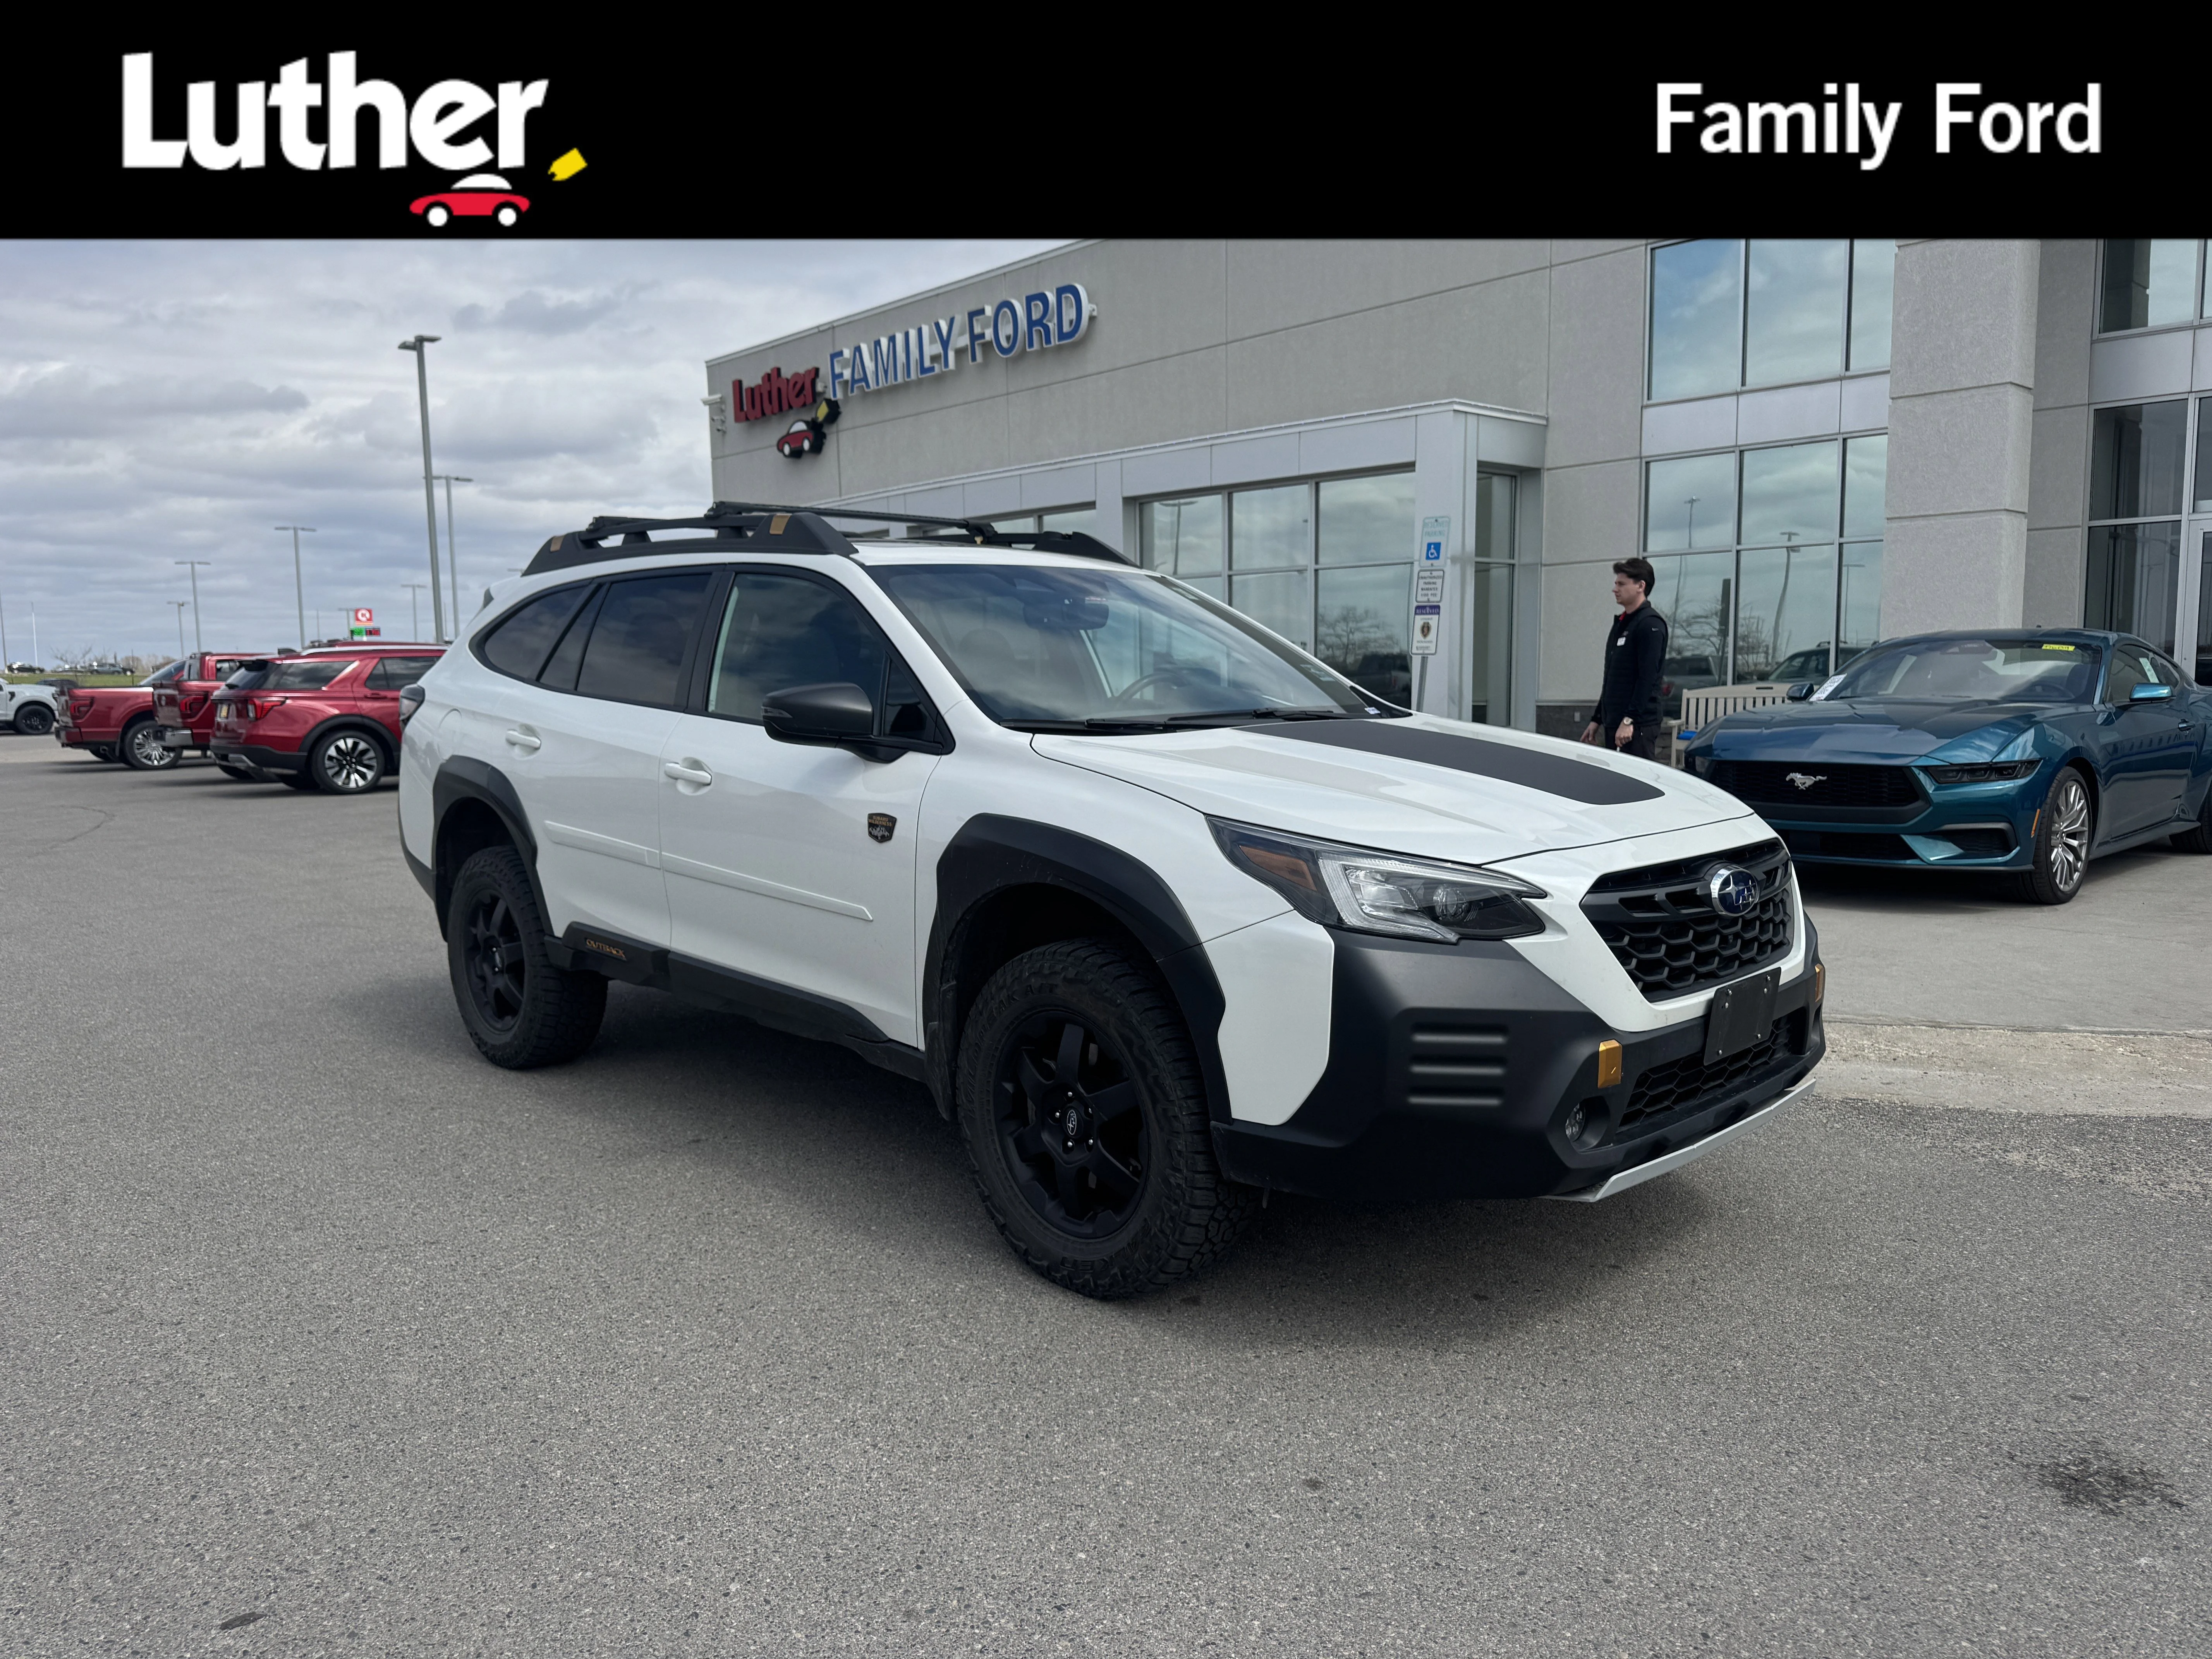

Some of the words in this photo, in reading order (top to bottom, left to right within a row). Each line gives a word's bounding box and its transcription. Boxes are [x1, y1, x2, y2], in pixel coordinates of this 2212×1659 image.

[828, 314, 961, 400] FAMILY
[968, 283, 1089, 363] FORD
[732, 366, 819, 423] Luther
[586, 939, 625, 958] OUTBACK
